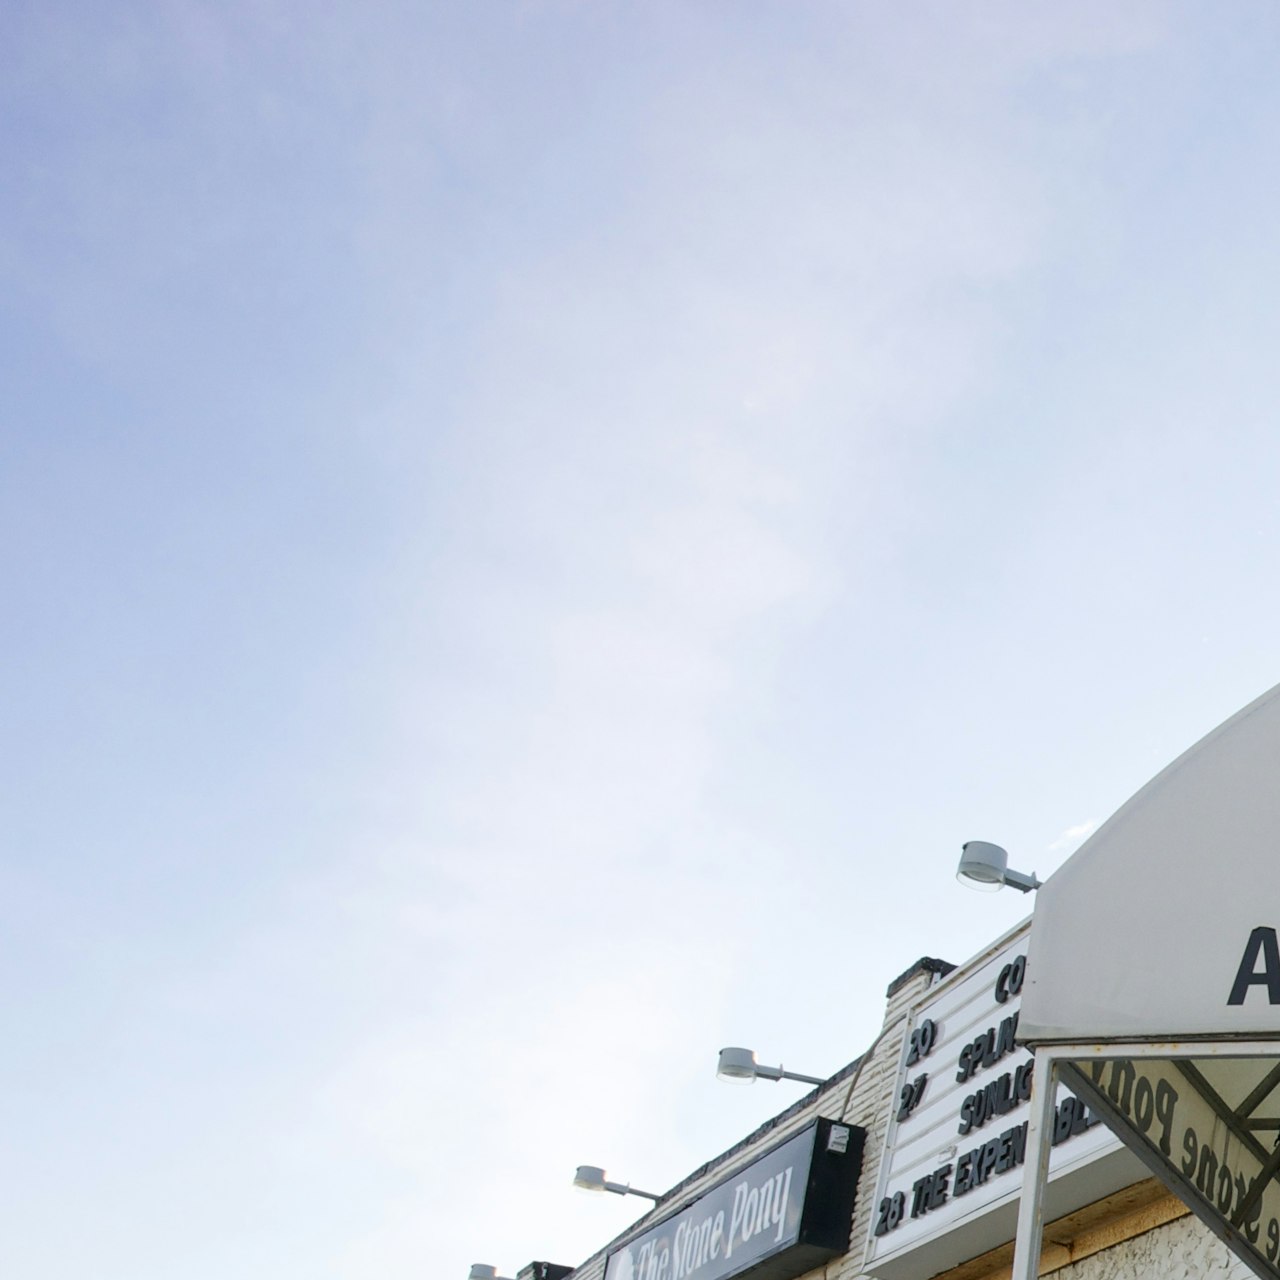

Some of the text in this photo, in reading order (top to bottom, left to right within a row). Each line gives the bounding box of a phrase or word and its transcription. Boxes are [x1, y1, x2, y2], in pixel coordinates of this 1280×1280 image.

[905, 1018, 936, 1067] 20
[897, 1072, 928, 1123] 27
[725, 1166, 794, 1260] Pony
[875, 1190, 905, 1237] 28
[911, 1163, 954, 1218] THE
